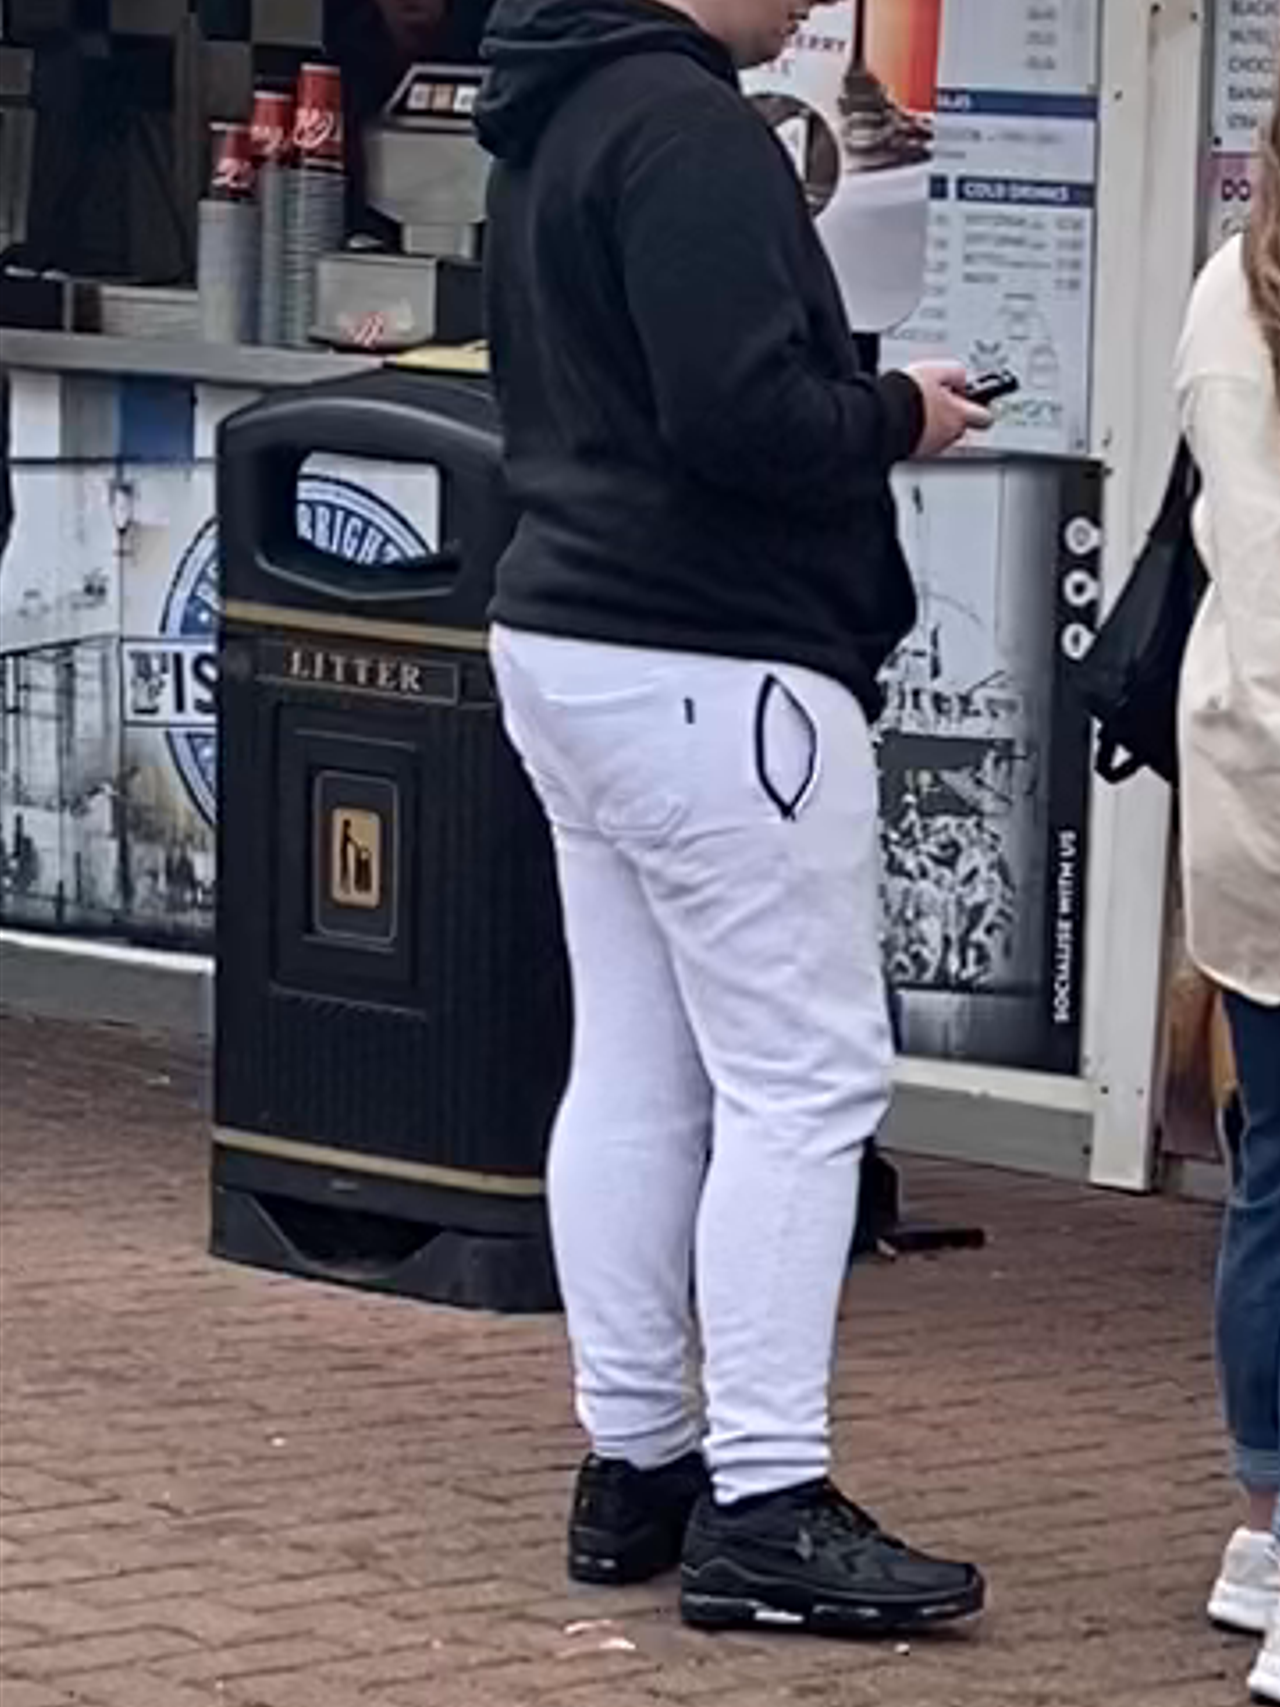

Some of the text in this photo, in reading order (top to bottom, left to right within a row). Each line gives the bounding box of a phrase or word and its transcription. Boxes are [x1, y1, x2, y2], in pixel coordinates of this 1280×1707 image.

[127, 651, 217, 715] FIS
[288, 650, 423, 692] LITTER
[1058, 830, 1077, 858] US
[1057, 862, 1075, 914] WITH
